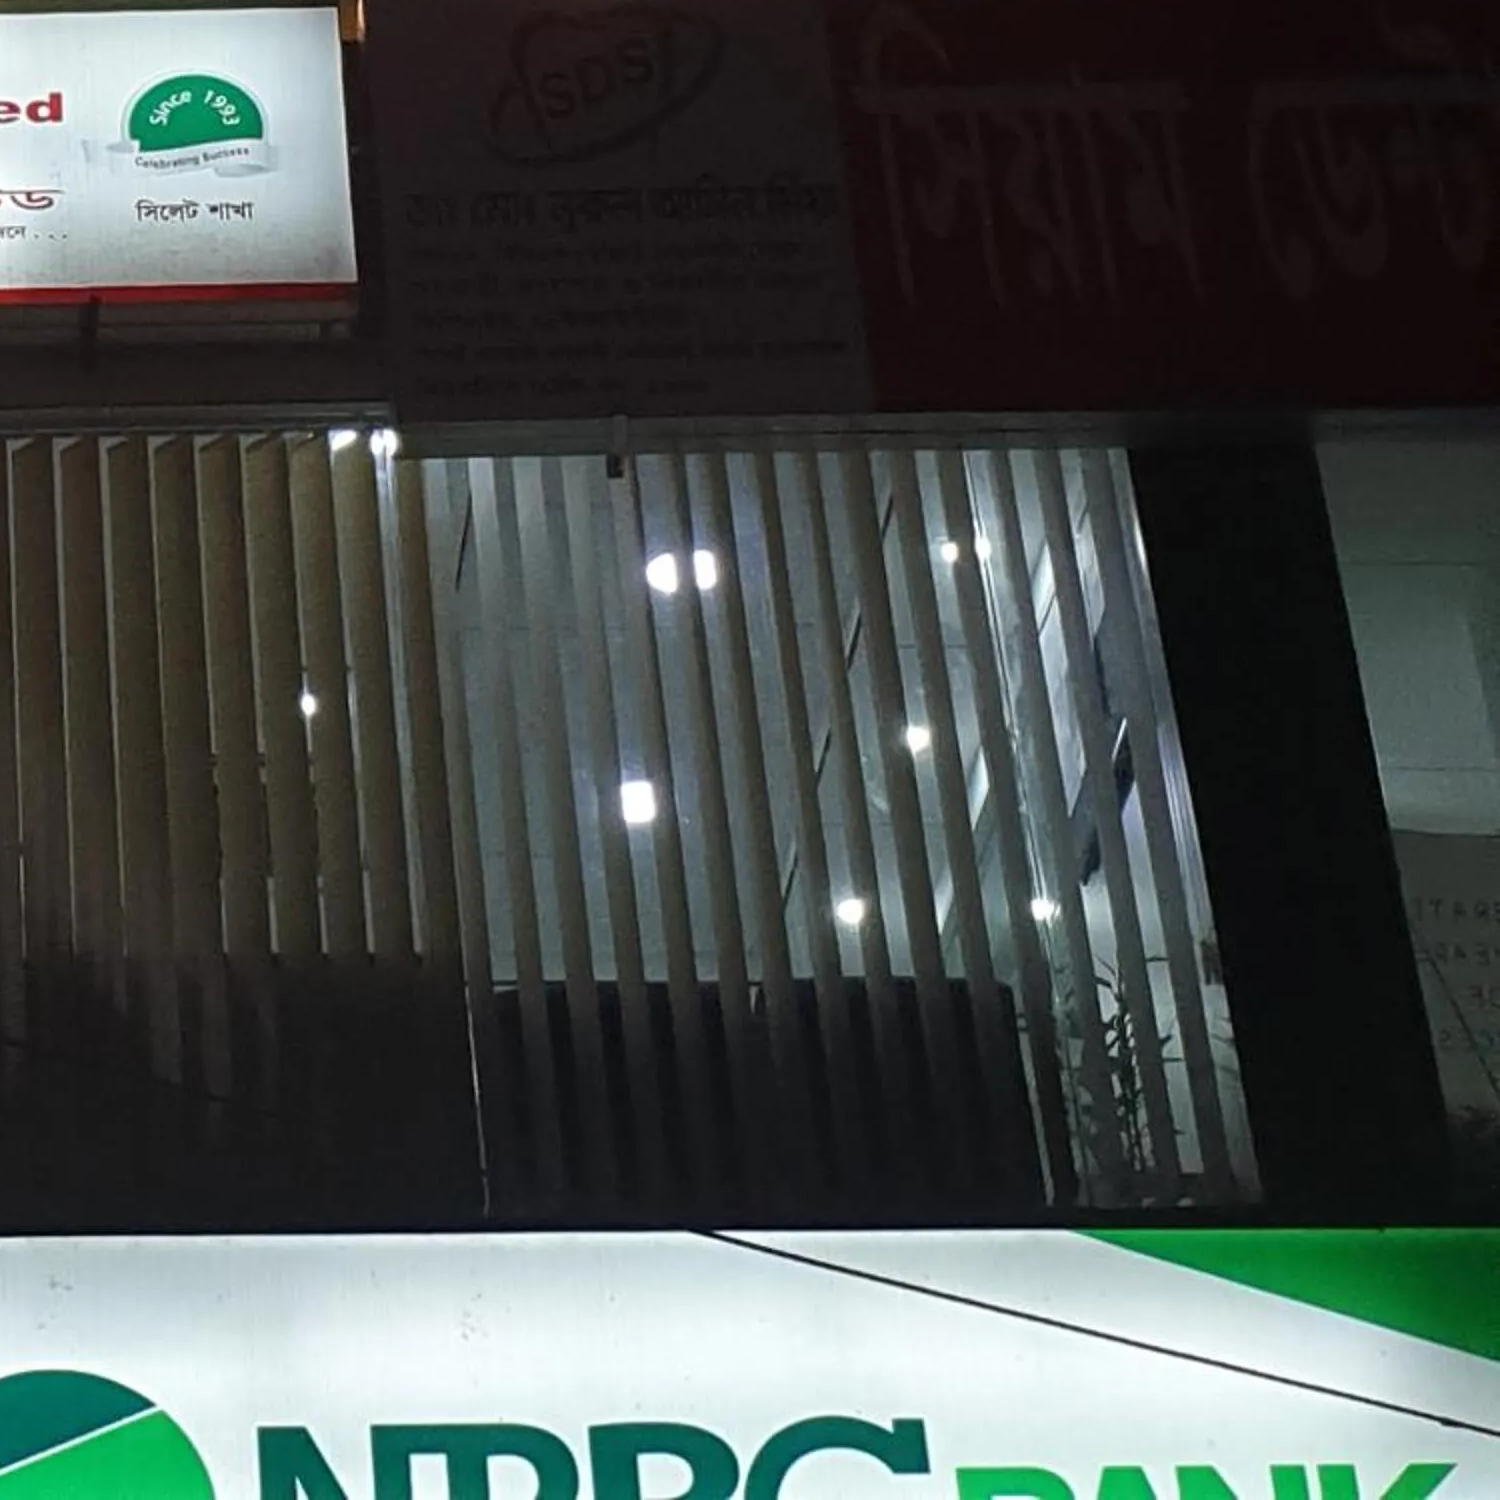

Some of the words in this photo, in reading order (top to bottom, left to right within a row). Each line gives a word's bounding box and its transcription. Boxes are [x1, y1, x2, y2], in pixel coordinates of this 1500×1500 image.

[149, 89, 193, 127] Since
[203, 89, 241, 127] 1993
[135, 198, 199, 222] সিলেট
